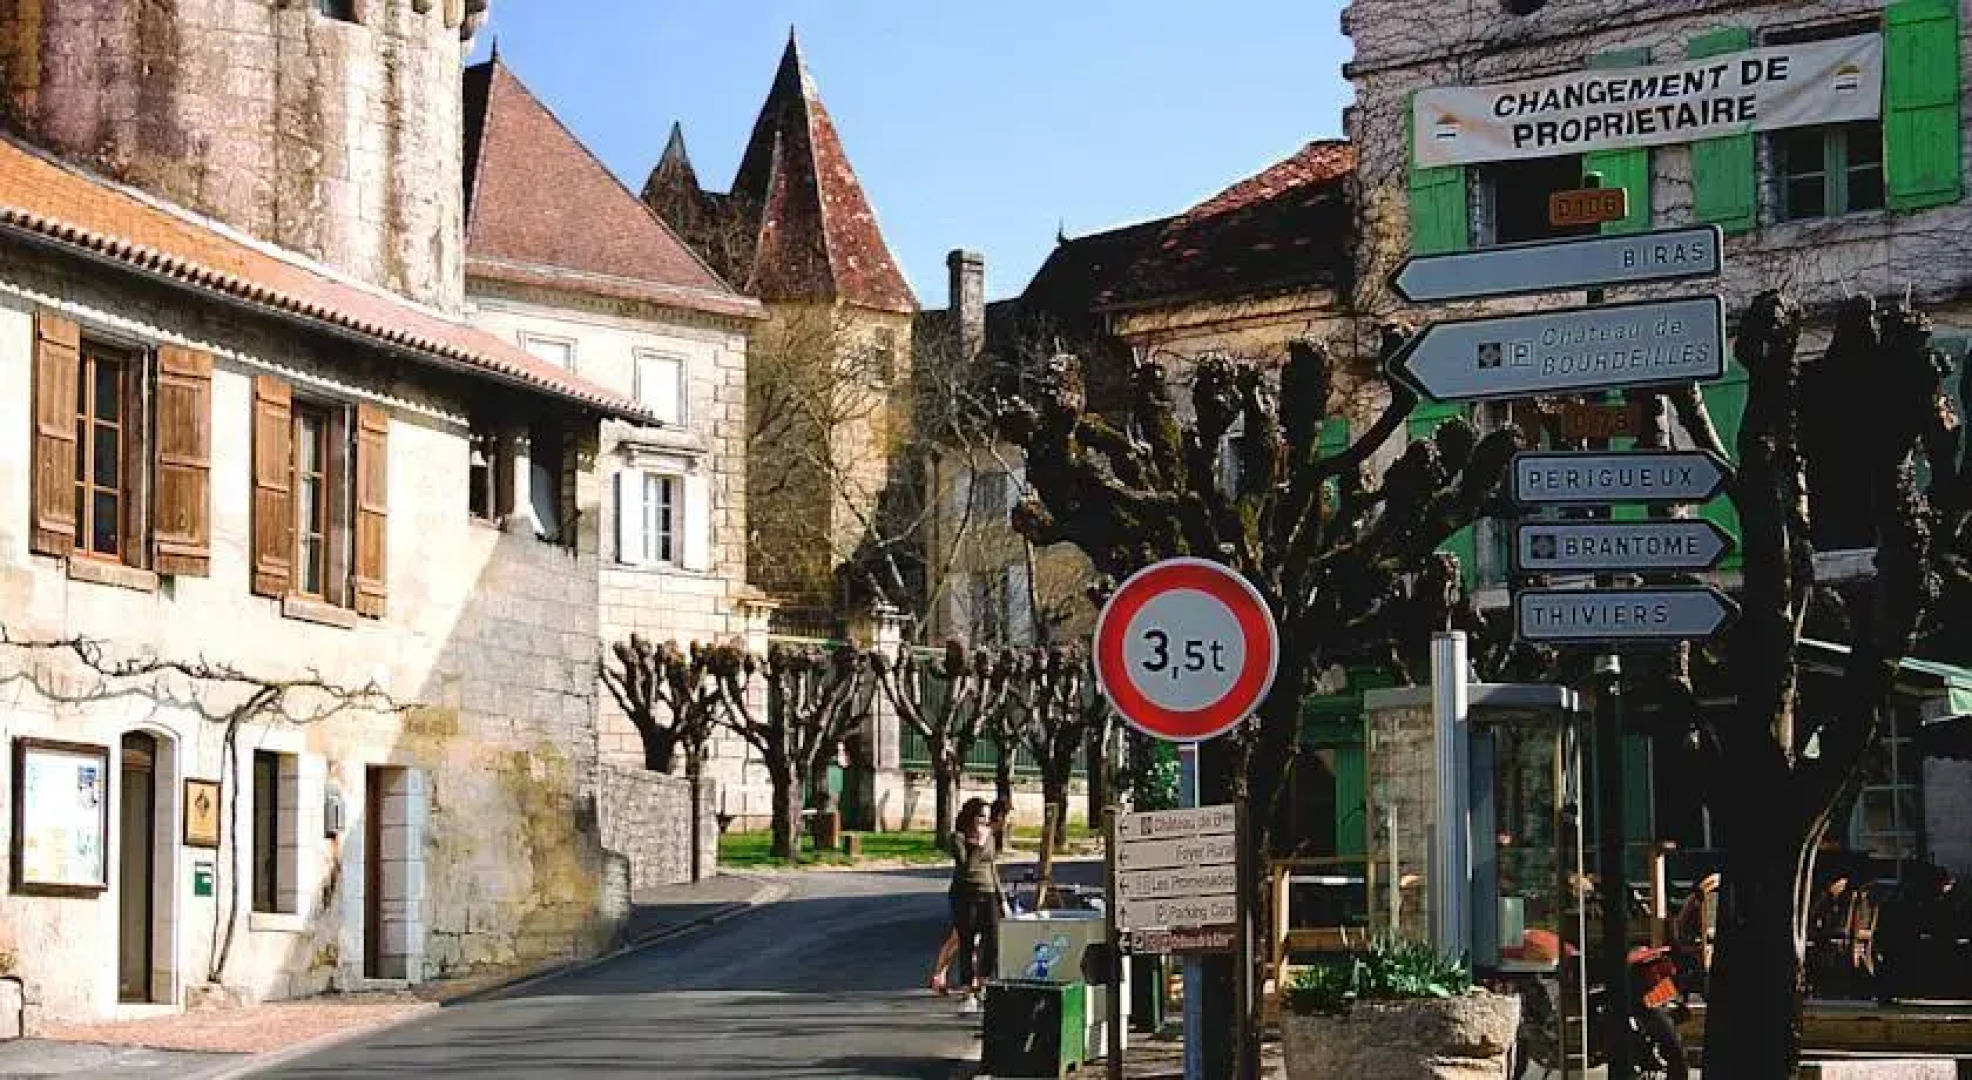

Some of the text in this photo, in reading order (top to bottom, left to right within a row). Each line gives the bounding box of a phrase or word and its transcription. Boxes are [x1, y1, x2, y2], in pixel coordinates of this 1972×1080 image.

[1493, 55, 1790, 118] CHANGEMENT DE
[1513, 94, 1758, 150] PROPRIETAIRE
[1623, 242, 1706, 268] BIRAS
[1654, 317, 1683, 338] de
[1541, 344, 1710, 376] BOURDEILLES
[1529, 466, 1693, 490] PERIGUEUX
[1564, 537, 1700, 557] BRANTOME
[1531, 604, 1670, 626] THIVIERS
[1142, 629, 1225, 679] 3,5t
